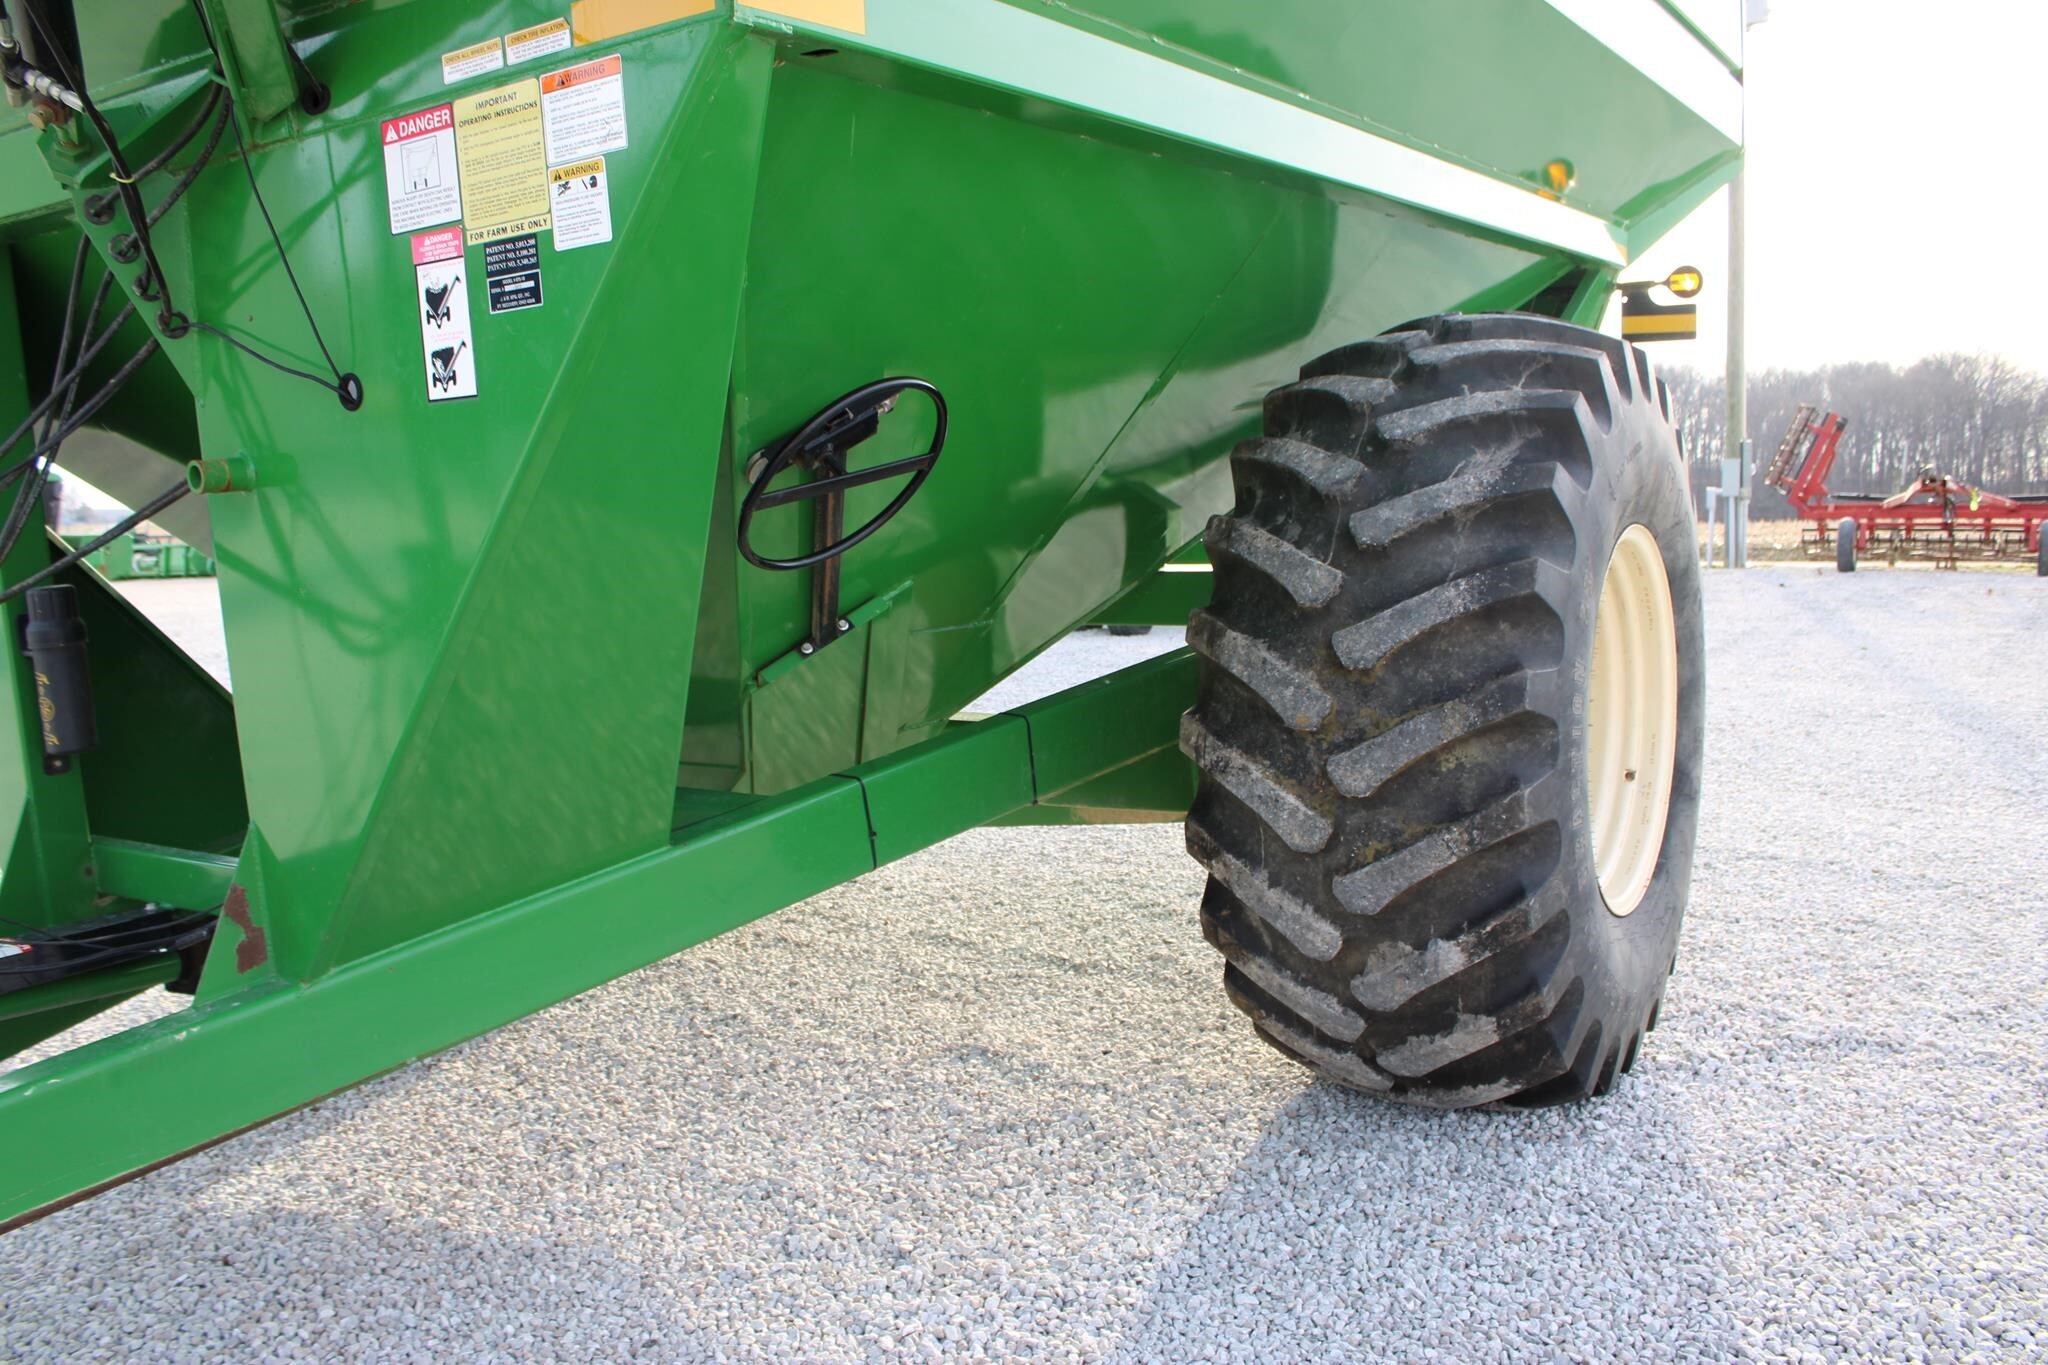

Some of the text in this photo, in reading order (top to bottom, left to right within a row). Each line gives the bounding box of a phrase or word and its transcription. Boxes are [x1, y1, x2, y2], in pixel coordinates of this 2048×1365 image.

[565, 64, 606, 83] WARNING
[475, 92, 517, 110] IMPORTANT
[458, 100, 538, 128] OPERATING INSTRUCTIONS
[398, 108, 451, 138] DANGER
[563, 162, 600, 178] WARNING
[430, 232, 453, 244] DANGER
[469, 217, 549, 242] FOR FARM USE ONLY
[486, 244, 505, 255] PATENT
[486, 253, 506, 263] PATENT
[487, 262, 507, 272] PATENT
